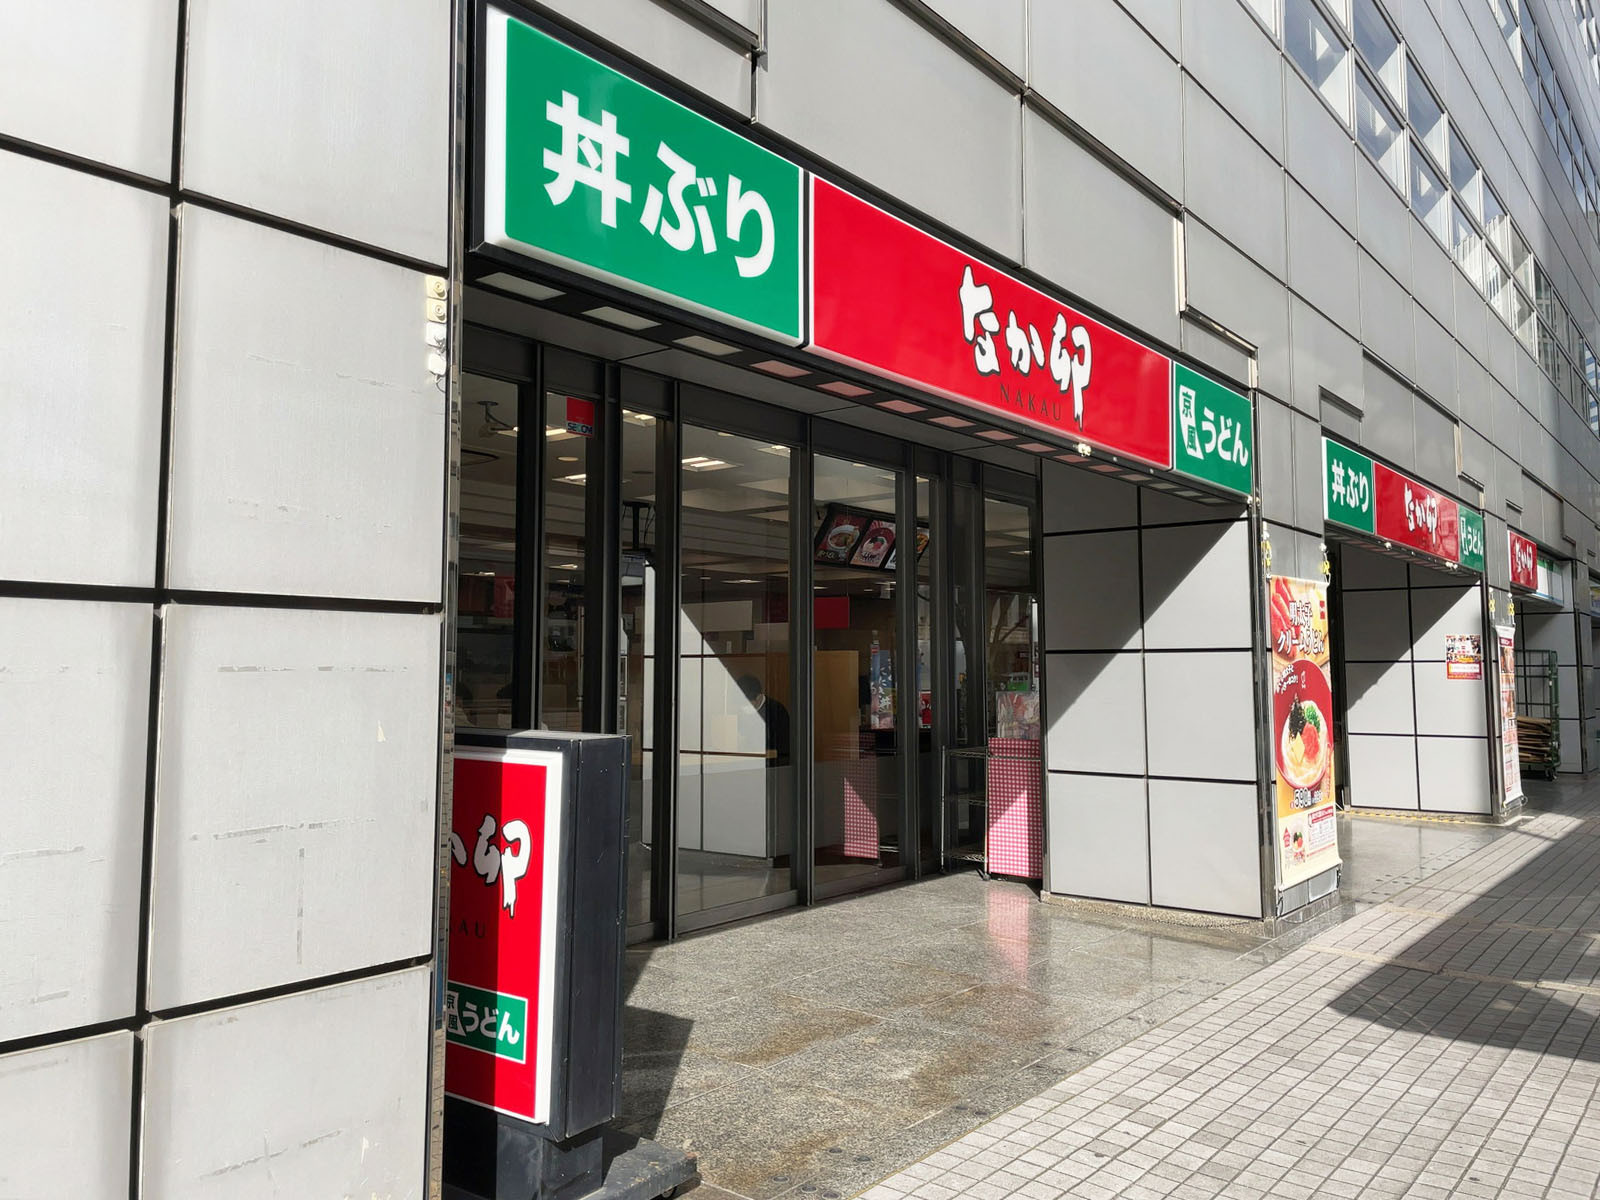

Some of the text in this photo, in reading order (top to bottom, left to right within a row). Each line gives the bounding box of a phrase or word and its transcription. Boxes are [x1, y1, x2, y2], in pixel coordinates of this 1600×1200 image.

[542, 89, 776, 279] 丼ぶり
[1000, 383, 1062, 421] NAKAU
[567, 422, 593, 435] SECOM
[1201, 406, 1249, 467] うどん
[1331, 458, 1369, 513] 丼ぶり
[462, 1001, 520, 1045] うどん
